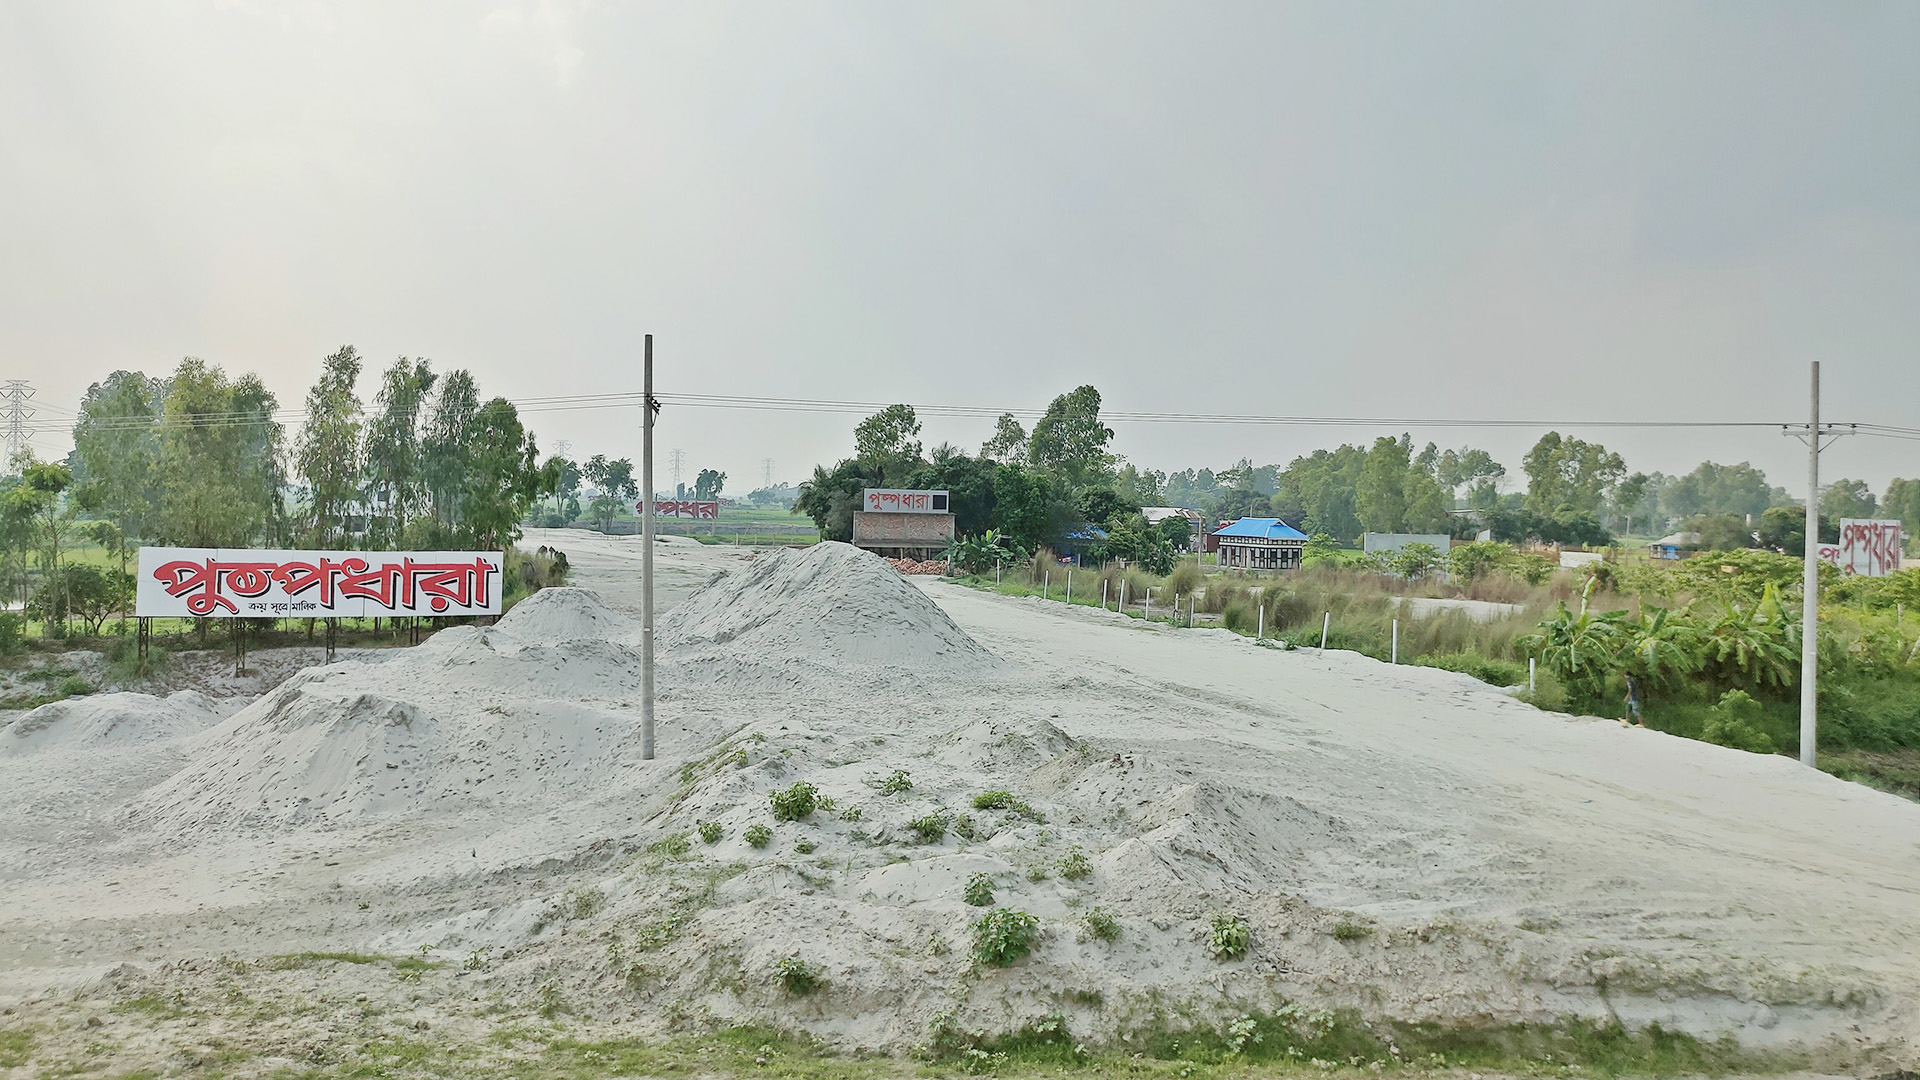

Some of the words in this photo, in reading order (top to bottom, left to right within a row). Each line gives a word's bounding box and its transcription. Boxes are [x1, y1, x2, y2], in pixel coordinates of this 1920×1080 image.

[869, 492, 930, 510] পুষ্পধারা
[153, 557, 499, 615] পুষ্পধারা
[249, 603, 268, 612] ক্রয়
[271, 603, 288, 614] সূত্রে
[292, 600, 318, 611] মালিক
